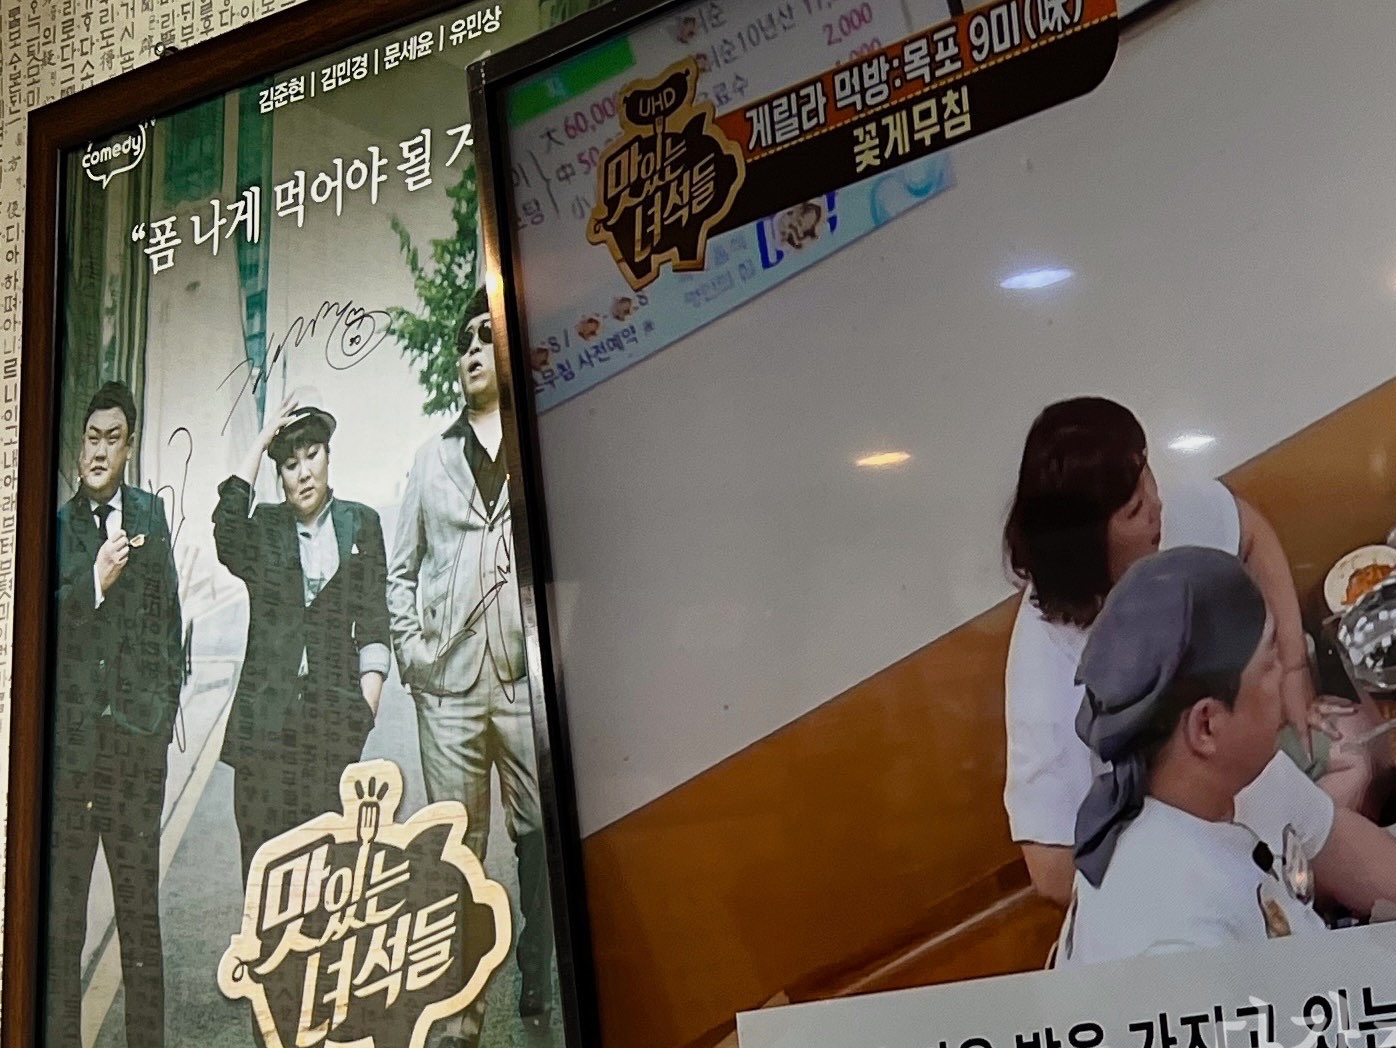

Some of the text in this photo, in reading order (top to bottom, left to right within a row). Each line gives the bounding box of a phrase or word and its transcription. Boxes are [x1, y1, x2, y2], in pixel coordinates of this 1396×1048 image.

[258, 5, 502, 114] 김준현 김민경 문세윤 유민상
[639, 87, 677, 117] UHD
[81, 135, 142, 170] comedy
[745, 82, 827, 151] 게릴라
[853, 85, 973, 174] 꽃게무침
[191, 186, 261, 257] 나게
[274, 145, 388, 228] 먹어야
[397, 128, 432, 192] 될
[605, 139, 688, 225] 맛있는
[633, 152, 718, 263] 녀석들
[255, 843, 410, 977] 맛있는
[297, 892, 459, 1048] 녀석들
